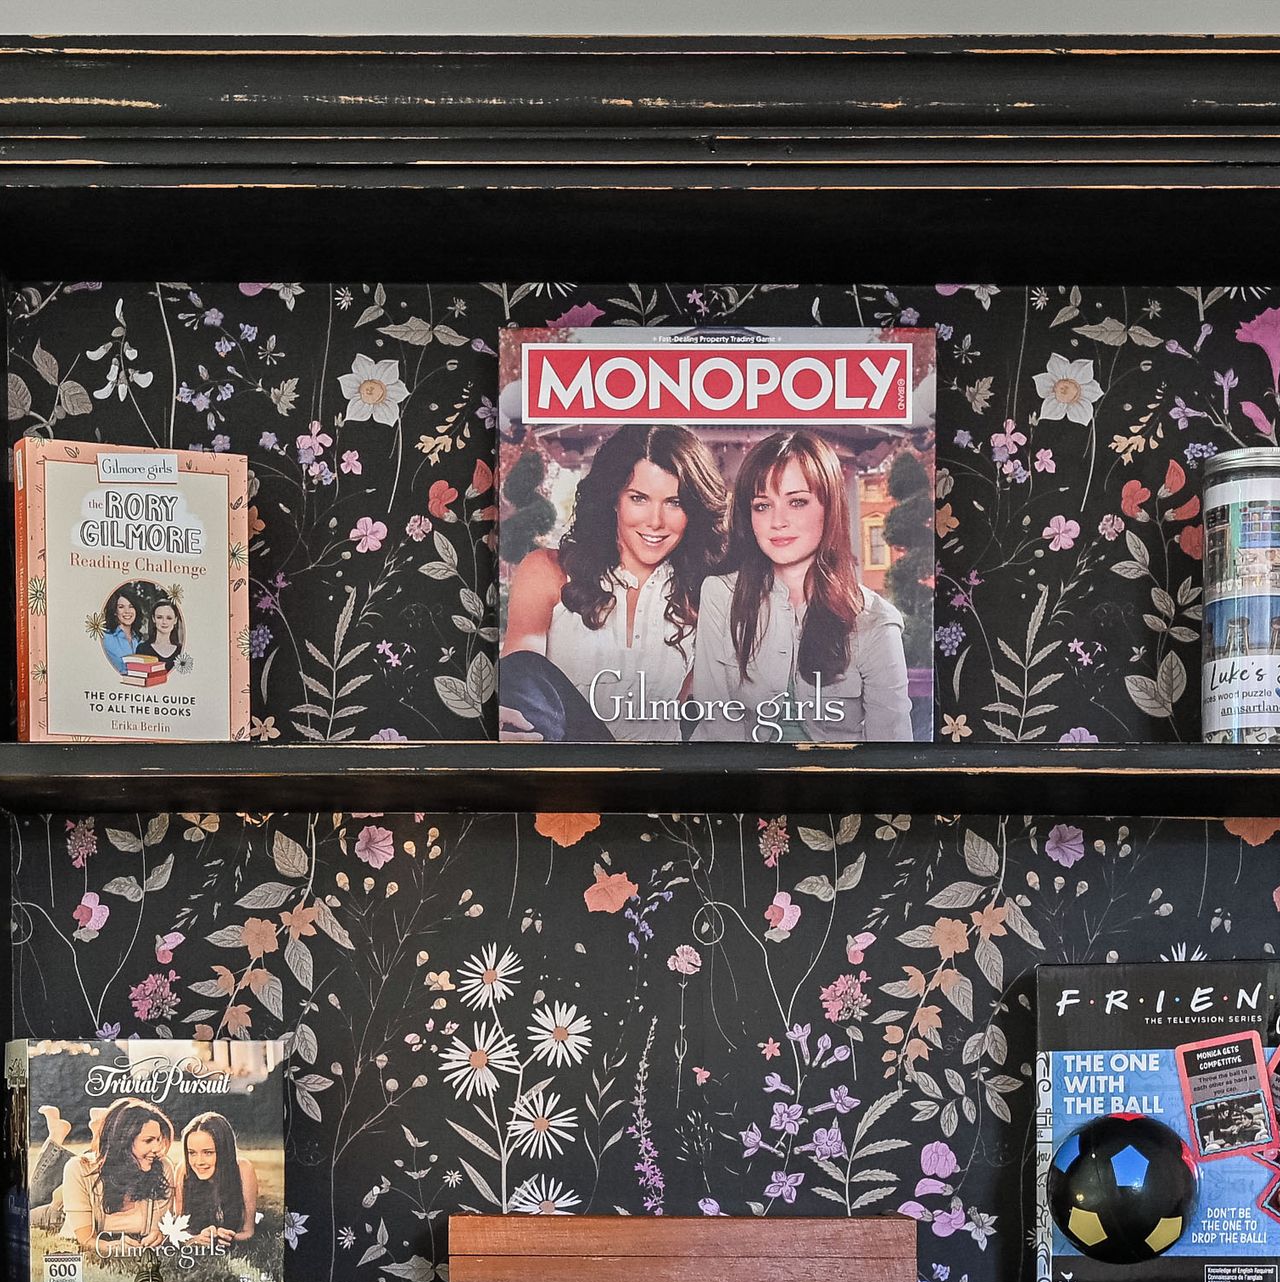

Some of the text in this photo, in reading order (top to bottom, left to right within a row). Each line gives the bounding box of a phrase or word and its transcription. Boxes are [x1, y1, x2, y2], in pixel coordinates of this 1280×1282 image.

[700, 336, 729, 344] Property
[730, 336, 754, 344] Trading
[538, 356, 900, 411] MONOPOLY
[101, 459, 173, 480] Gilmore girls
[88, 490, 178, 522] the RORY
[80, 520, 202, 554] GILMORE
[70, 552, 207, 579] Reading Challenge
[1210, 661, 1266, 691] Luke's
[84, 690, 196, 705] THE OFFICIAL GUIDE
[1242, 689, 1272, 700] puzzle
[90, 704, 192, 717] TO ALL THE BOOKS
[589, 669, 846, 742] Gilmore girls
[111, 720, 170, 733] Erika Berlin
[1144, 1014, 1262, 1024] THE TELEVISION SERIES
[1196, 1045, 1240, 1060] MONICA GETS
[1064, 1054, 1160, 1072] THE ONE
[1200, 1055, 1242, 1070] COMPETITIVE
[85, 1056, 232, 1103] Trivial Pursuit
[1064, 1076, 1124, 1094] WITH
[1194, 1084, 1208, 1092] each
[1064, 1096, 1164, 1114] THE BALL
[1208, 1208, 1252, 1220] DON'T BE
[1202, 1220, 1257, 1232] THE ONE TO
[1192, 1232, 1267, 1244] DROP THE BALL!
[179, 1229, 226, 1268] girls
[49, 1264, 76, 1277] 600
